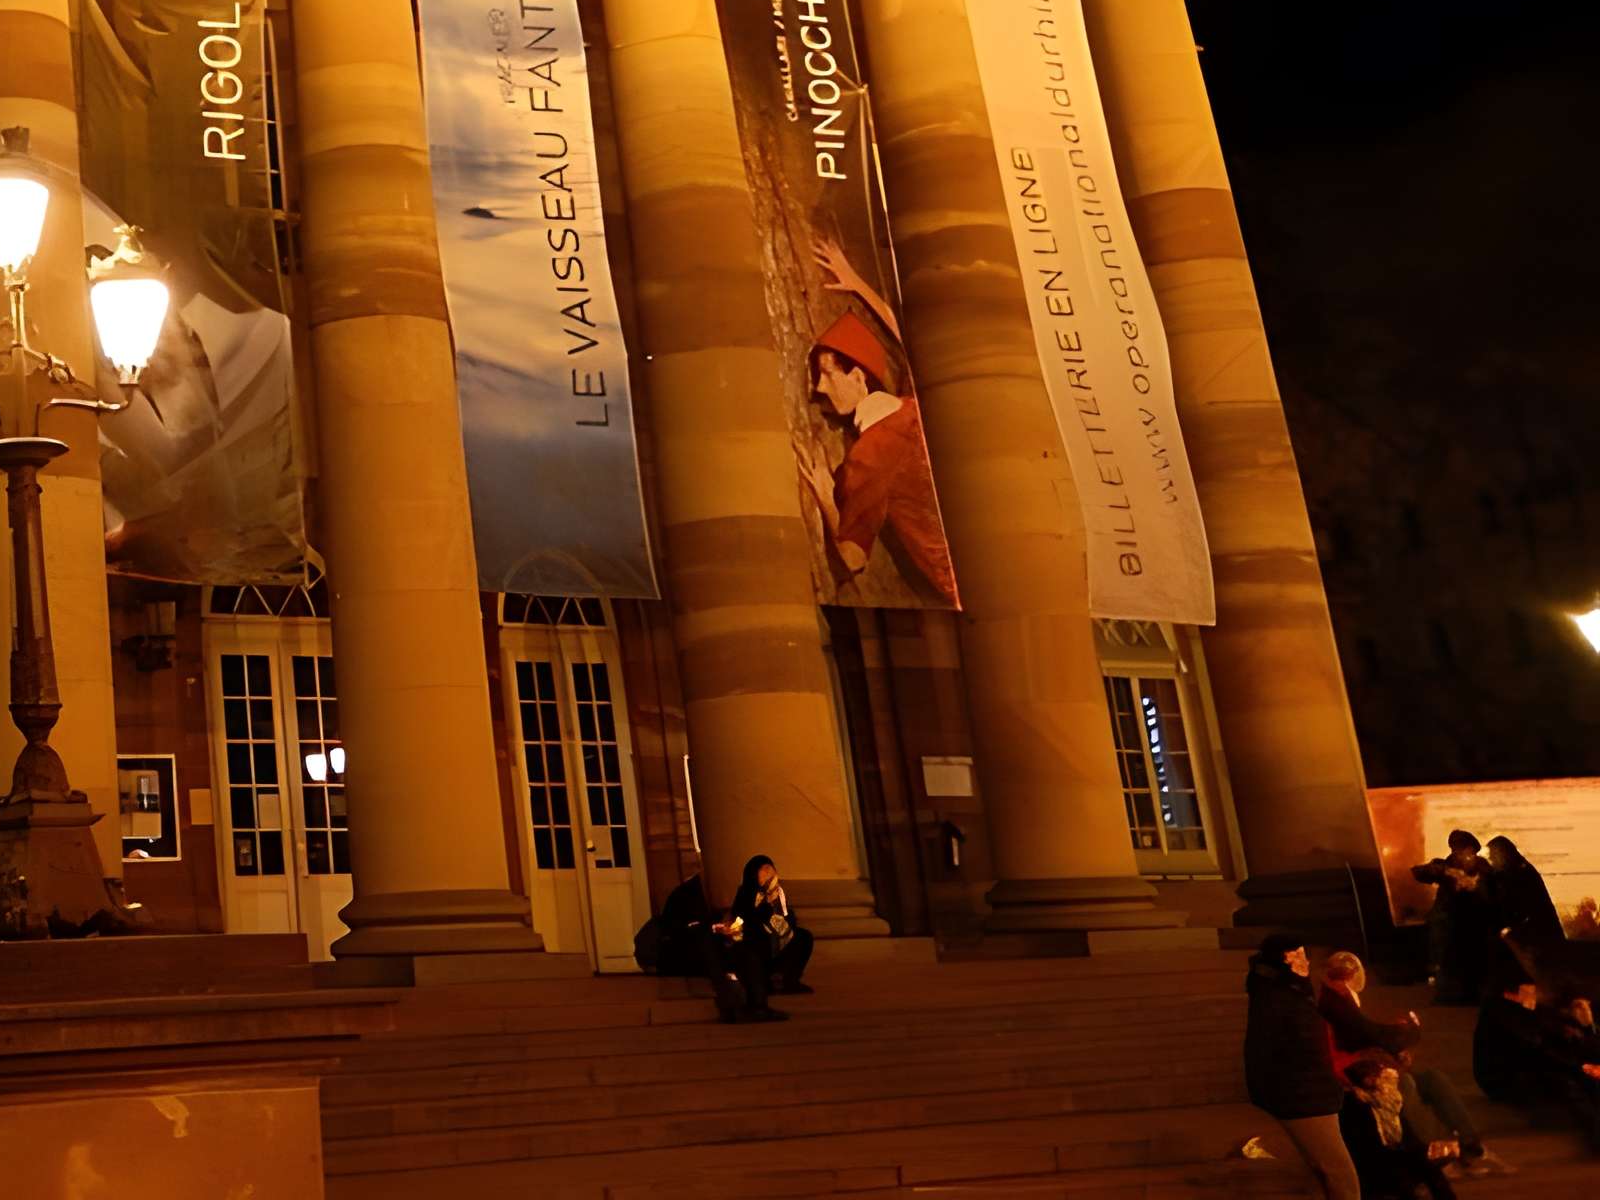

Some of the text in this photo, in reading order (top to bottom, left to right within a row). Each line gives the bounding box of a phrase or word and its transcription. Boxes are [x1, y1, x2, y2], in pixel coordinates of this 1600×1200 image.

[1010, 146, 1058, 255] LIGNE
[534, 133, 600, 356] VAISSEAU
[1038, 269, 1074, 316] EN
[572, 369, 609, 427] LE
